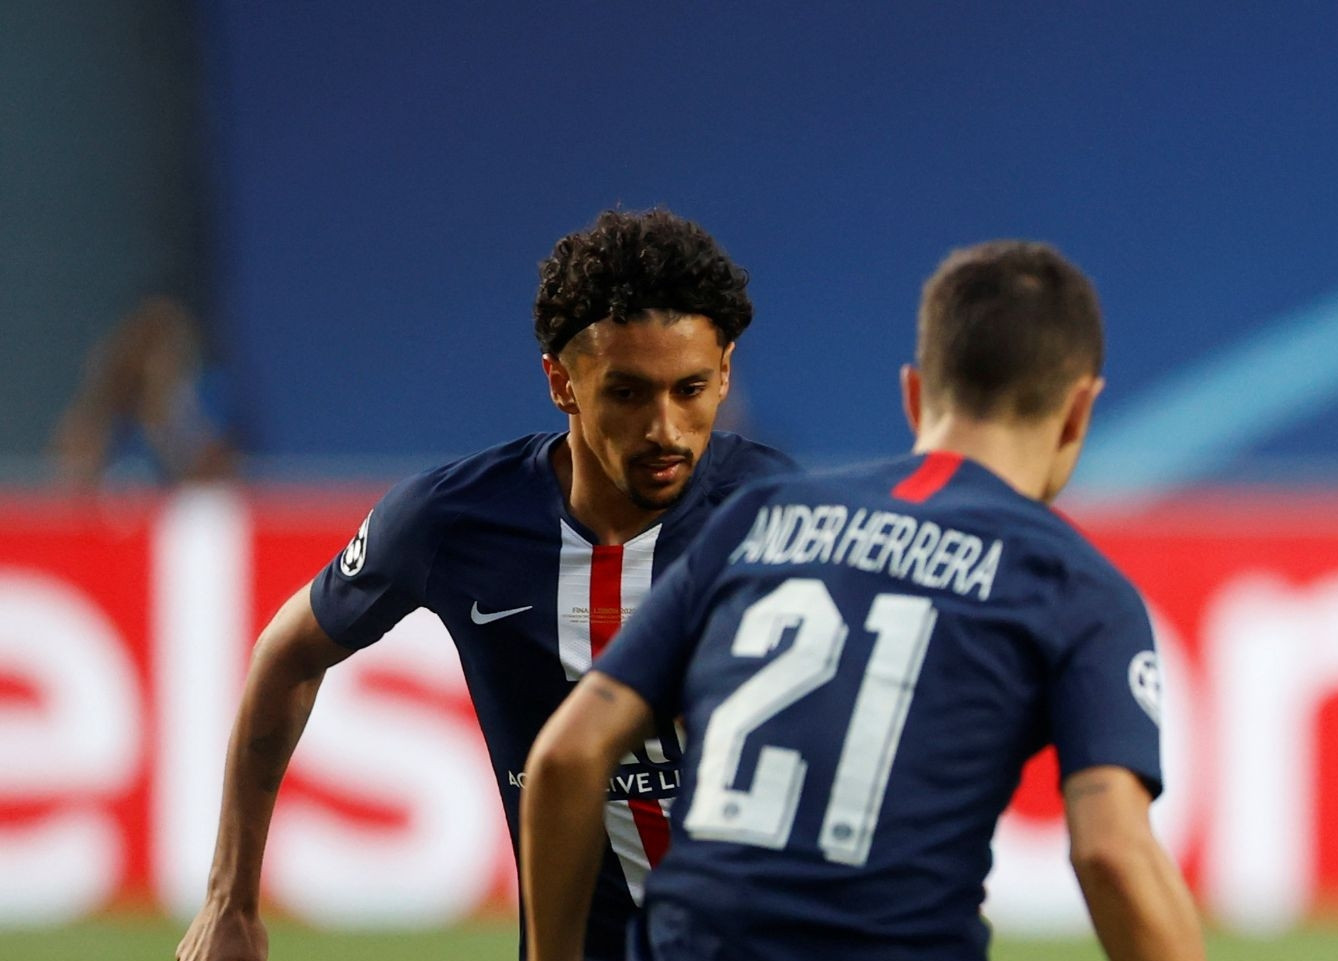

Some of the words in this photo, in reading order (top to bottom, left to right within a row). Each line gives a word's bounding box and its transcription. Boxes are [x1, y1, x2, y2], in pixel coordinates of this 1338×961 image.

[728, 504, 849, 566] ANDER
[832, 507, 1003, 601] HERRERA
[683, 578, 938, 866] 21
